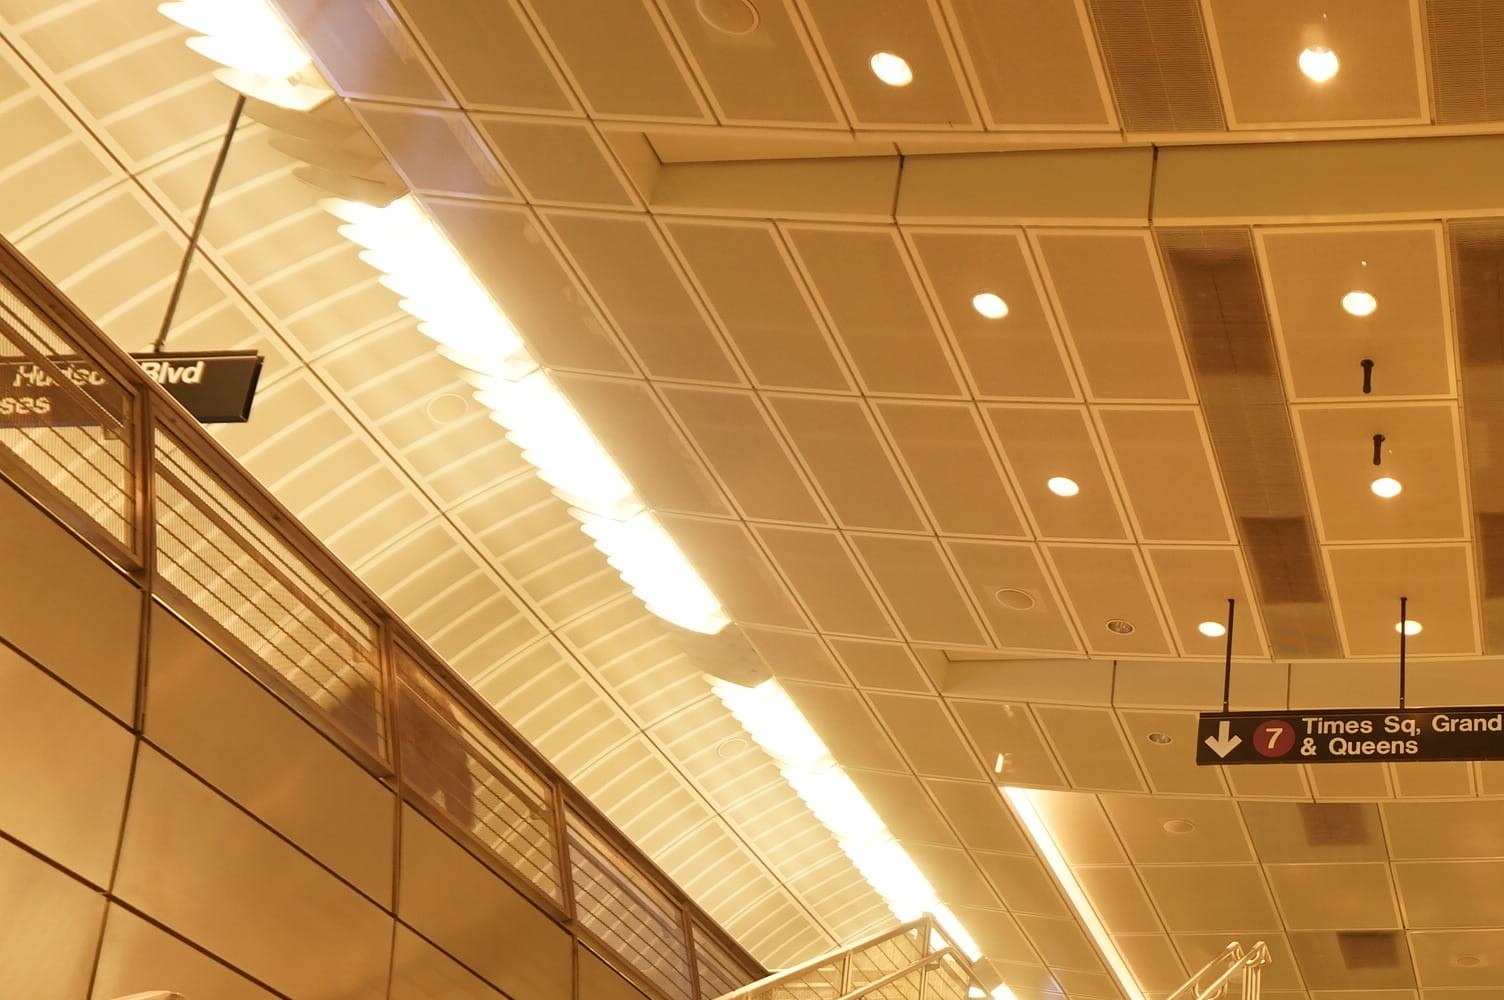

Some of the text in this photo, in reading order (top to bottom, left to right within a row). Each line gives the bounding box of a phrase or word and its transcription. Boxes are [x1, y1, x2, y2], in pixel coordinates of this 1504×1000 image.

[13, 361, 205, 388] Huso Blvd
[1301, 717, 1373, 734] Times
[1384, 715, 1421, 736] Sq,
[1431, 714, 1502, 732] Grand
[1265, 727, 1284, 750] 7
[1300, 737, 1419, 756] & Queens
